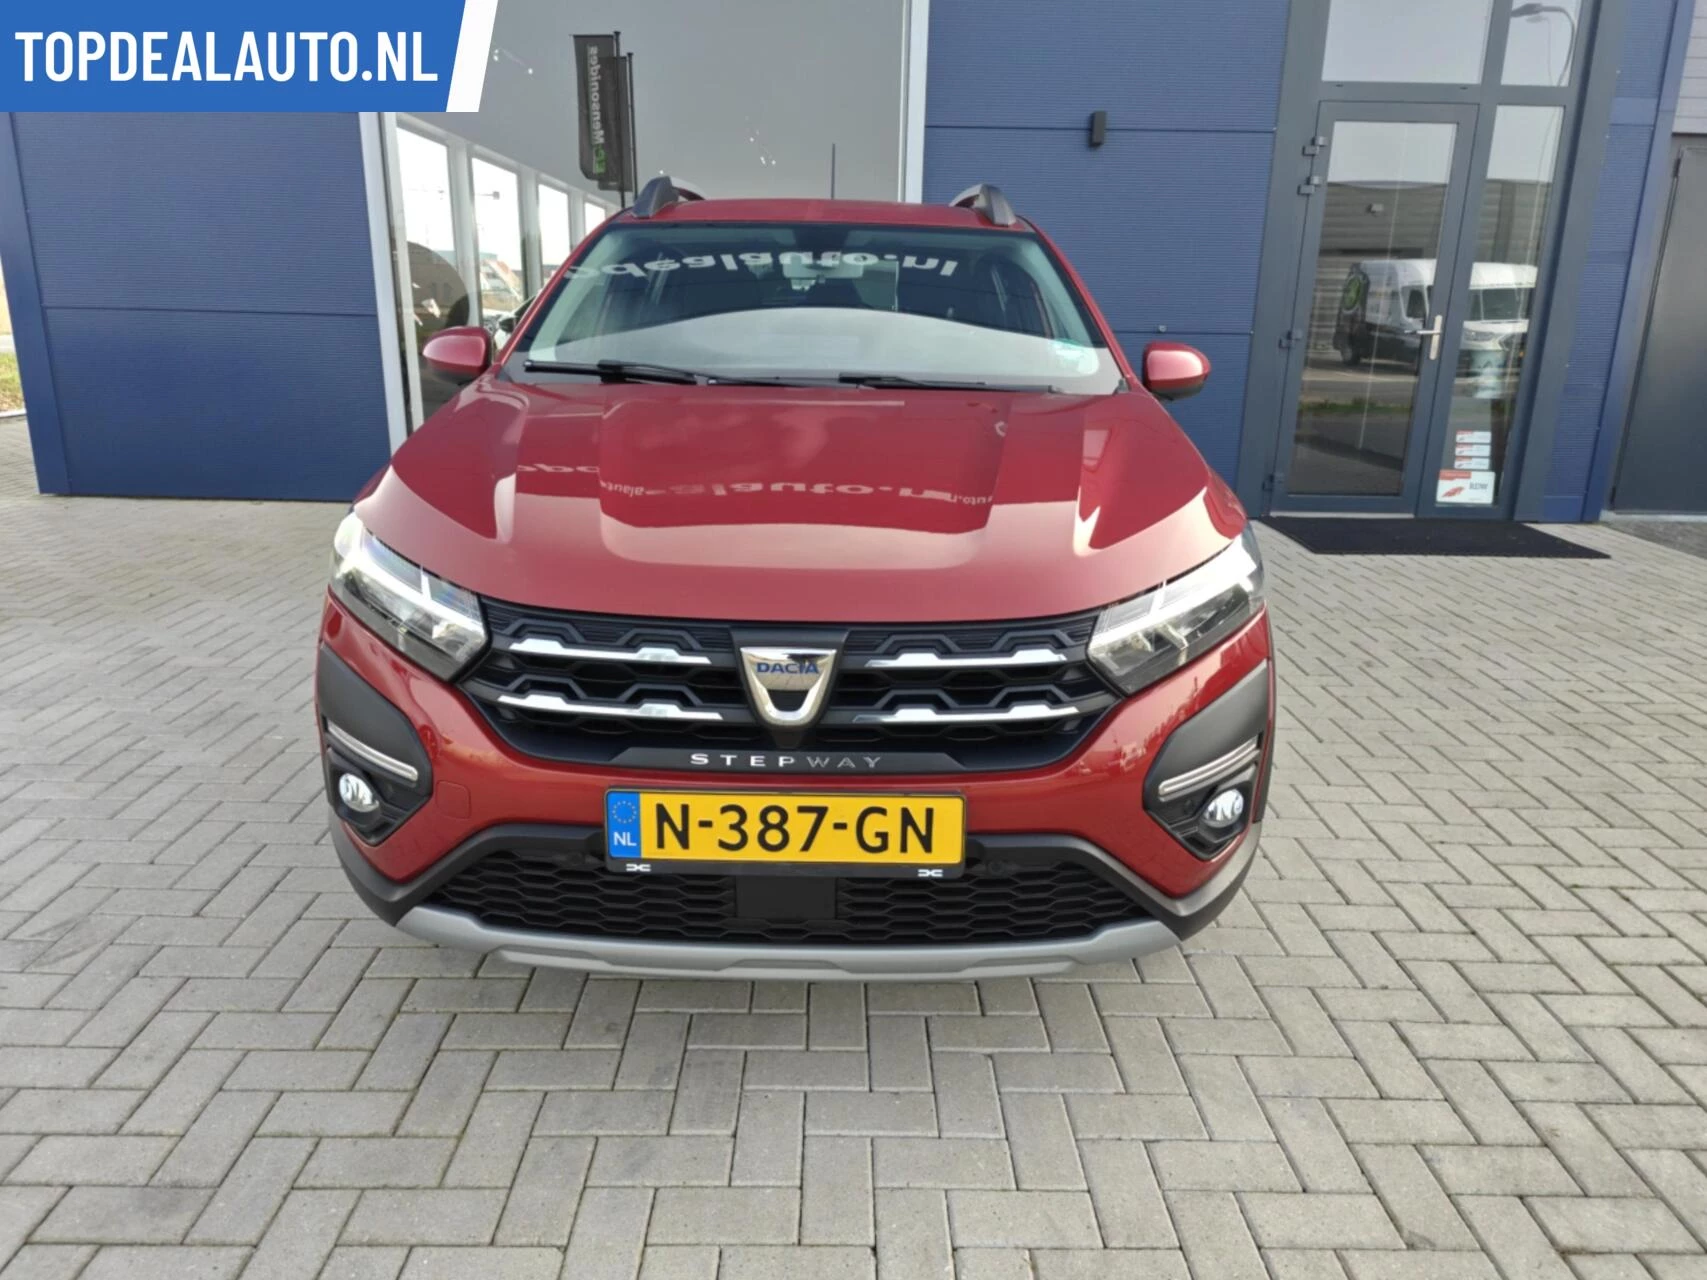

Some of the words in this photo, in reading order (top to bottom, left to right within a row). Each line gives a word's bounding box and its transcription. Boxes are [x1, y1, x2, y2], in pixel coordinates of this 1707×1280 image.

[756, 662, 820, 675] DACIA
[690, 753, 881, 769] STEPWAY
[655, 803, 935, 854] N-387-GN
[613, 831, 637, 847] NL
